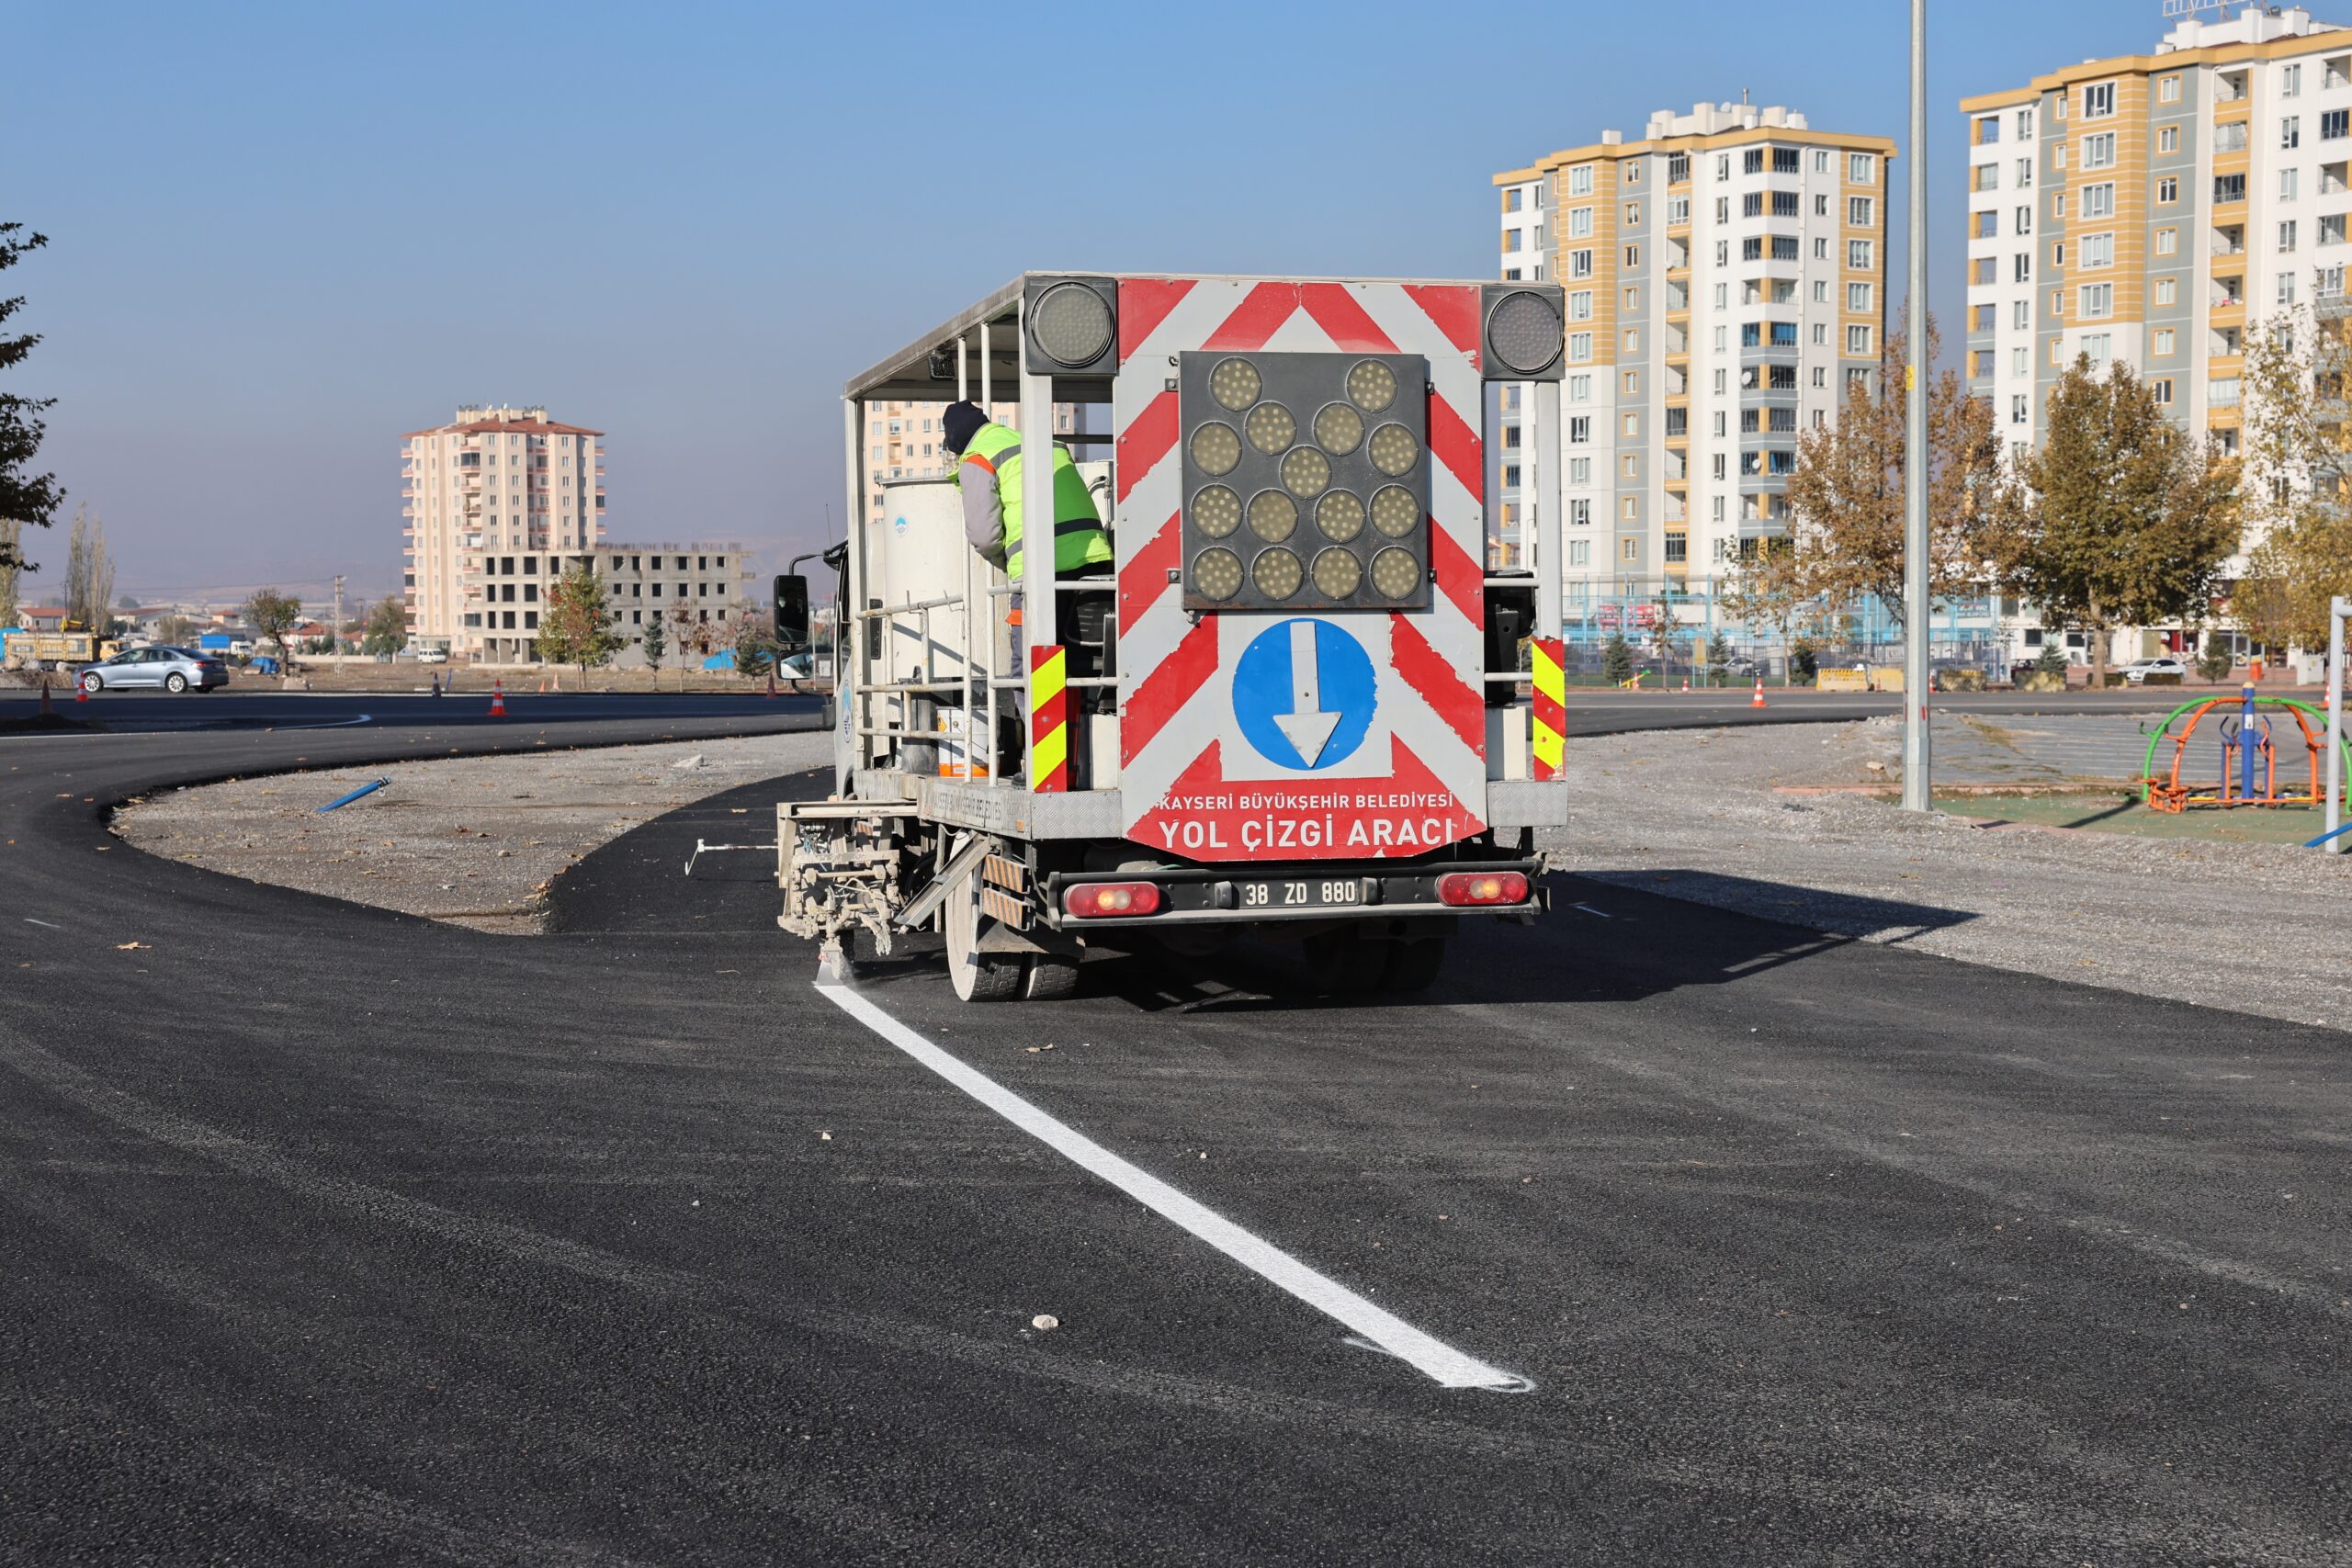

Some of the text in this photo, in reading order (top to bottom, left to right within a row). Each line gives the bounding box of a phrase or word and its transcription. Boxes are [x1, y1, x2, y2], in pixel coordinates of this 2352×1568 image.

[1159, 791, 1453, 810] KAYSERİ BÜYÜKŞEHİR BELEDİYESİ
[1159, 814, 1453, 852] YOL ÇİZGİ ARACI
[1246, 881, 1355, 905] 38 ZD 880
